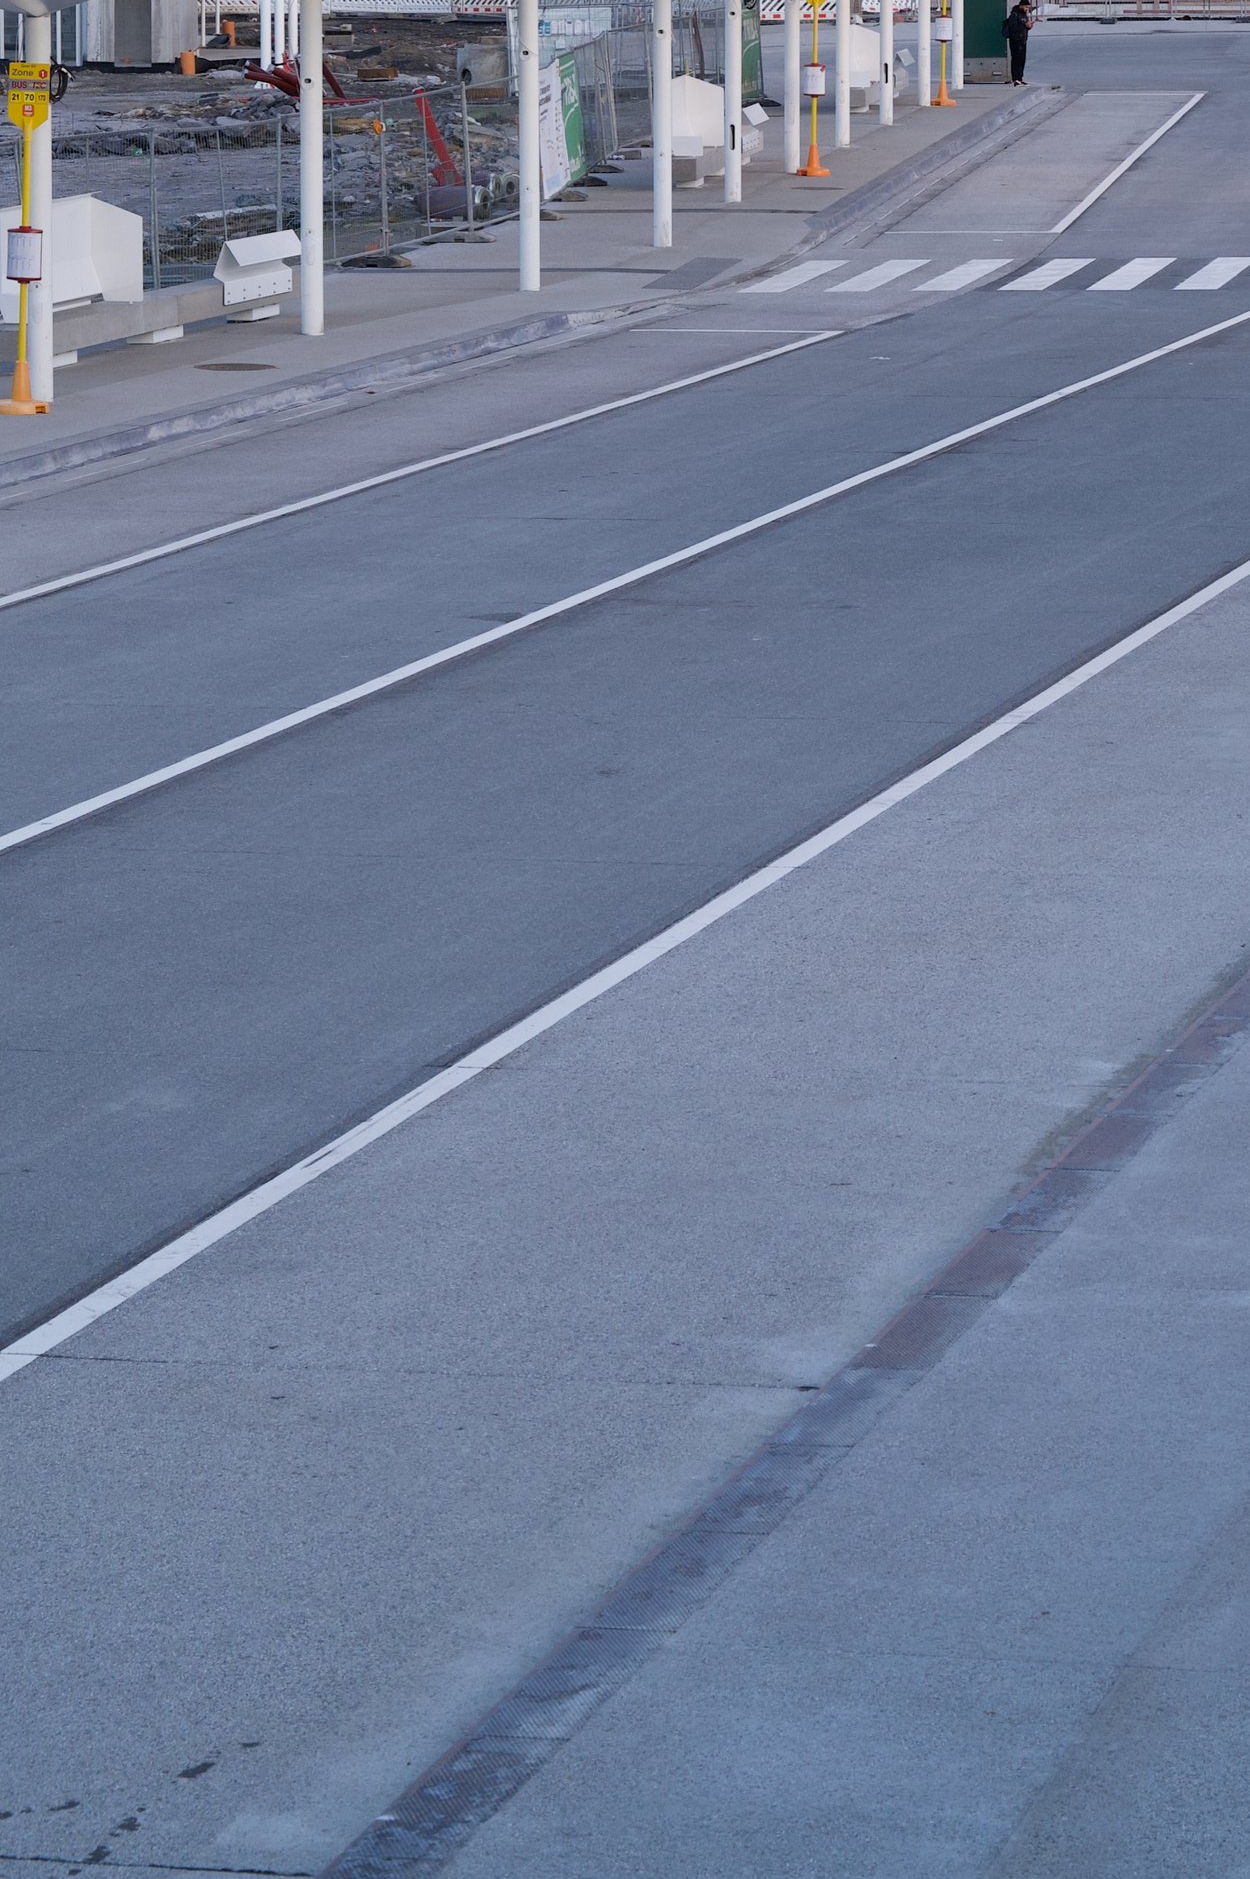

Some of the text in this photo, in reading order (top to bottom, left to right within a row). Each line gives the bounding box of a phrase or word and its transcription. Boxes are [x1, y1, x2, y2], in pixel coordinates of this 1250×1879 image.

[11, 68, 34, 77] Zone
[11, 81, 28, 89] BUS
[11, 93, 20, 101] 21
[24, 93, 35, 101] 70
